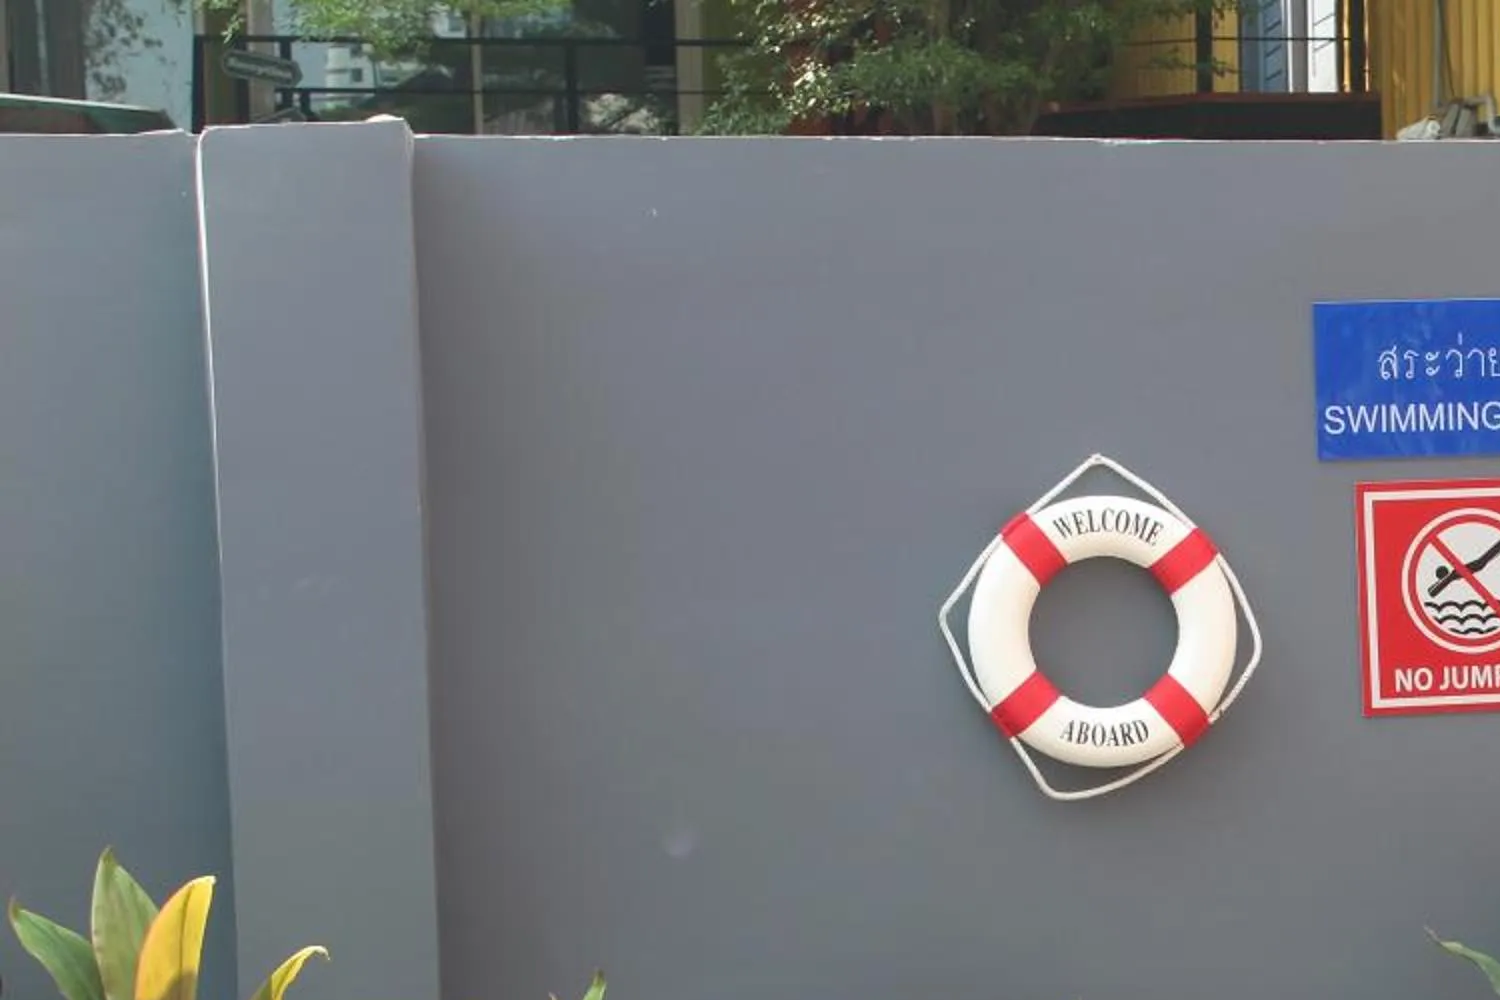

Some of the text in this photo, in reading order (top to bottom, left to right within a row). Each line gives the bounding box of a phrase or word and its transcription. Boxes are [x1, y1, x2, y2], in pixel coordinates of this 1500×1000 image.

[1052, 507, 1165, 546] WELCOME
[1394, 666, 1433, 693] NO
[1059, 718, 1150, 748] ABOARD
